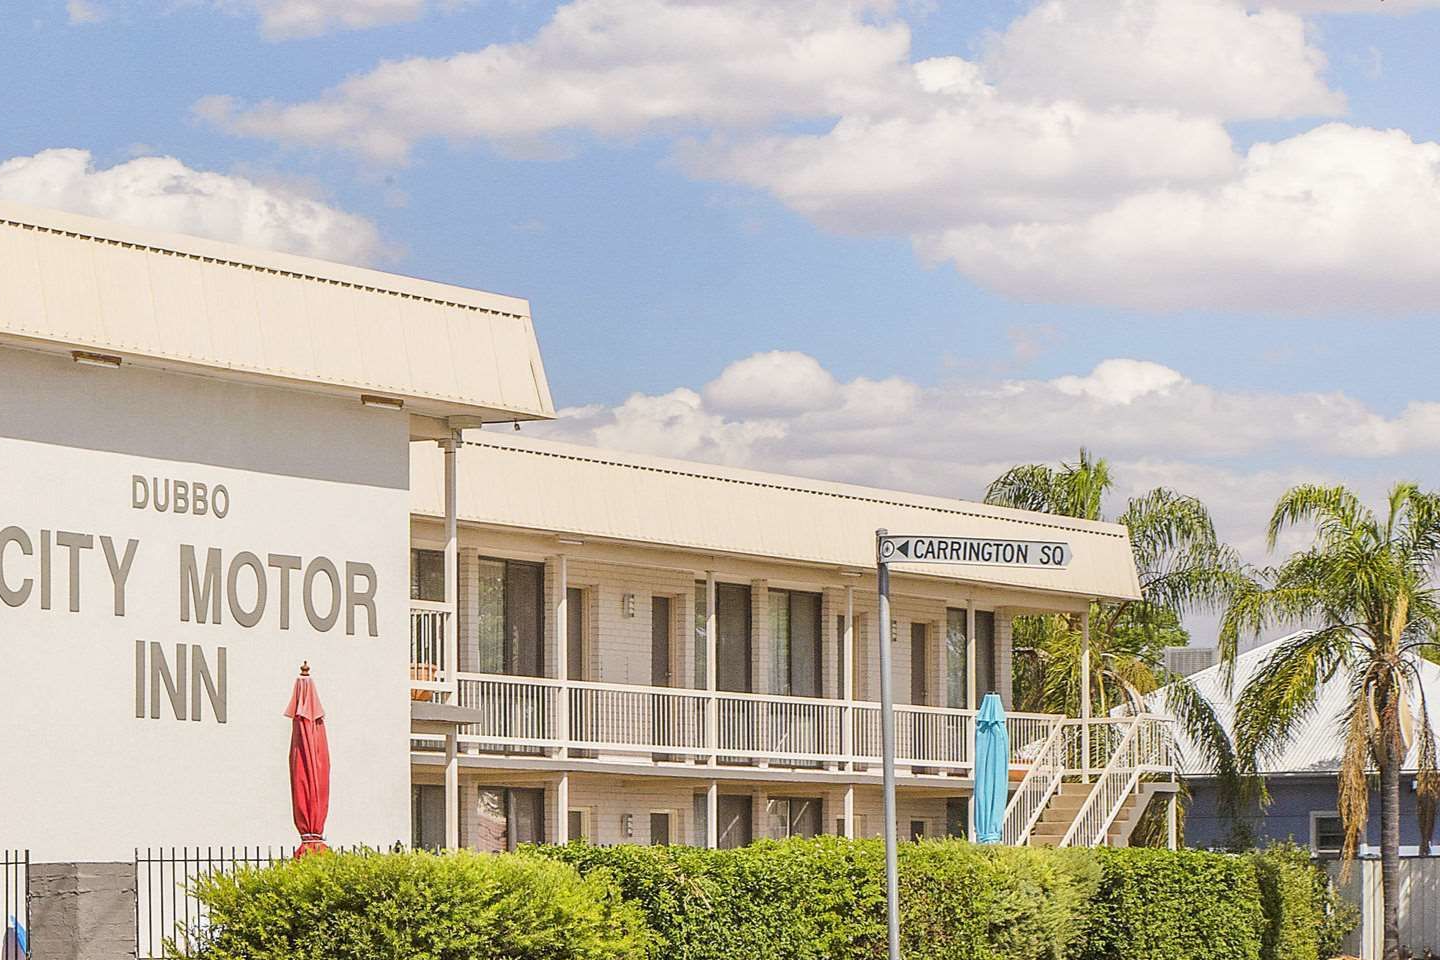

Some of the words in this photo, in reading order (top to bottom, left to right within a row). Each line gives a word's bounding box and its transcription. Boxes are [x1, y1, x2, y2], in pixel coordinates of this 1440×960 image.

[132, 474, 230, 519] DUBBO
[913, 539, 1029, 564] CARRINGTON
[1039, 545, 1064, 566] SQ
[179, 543, 379, 637] MOTOR
[135, 640, 227, 724] INN
